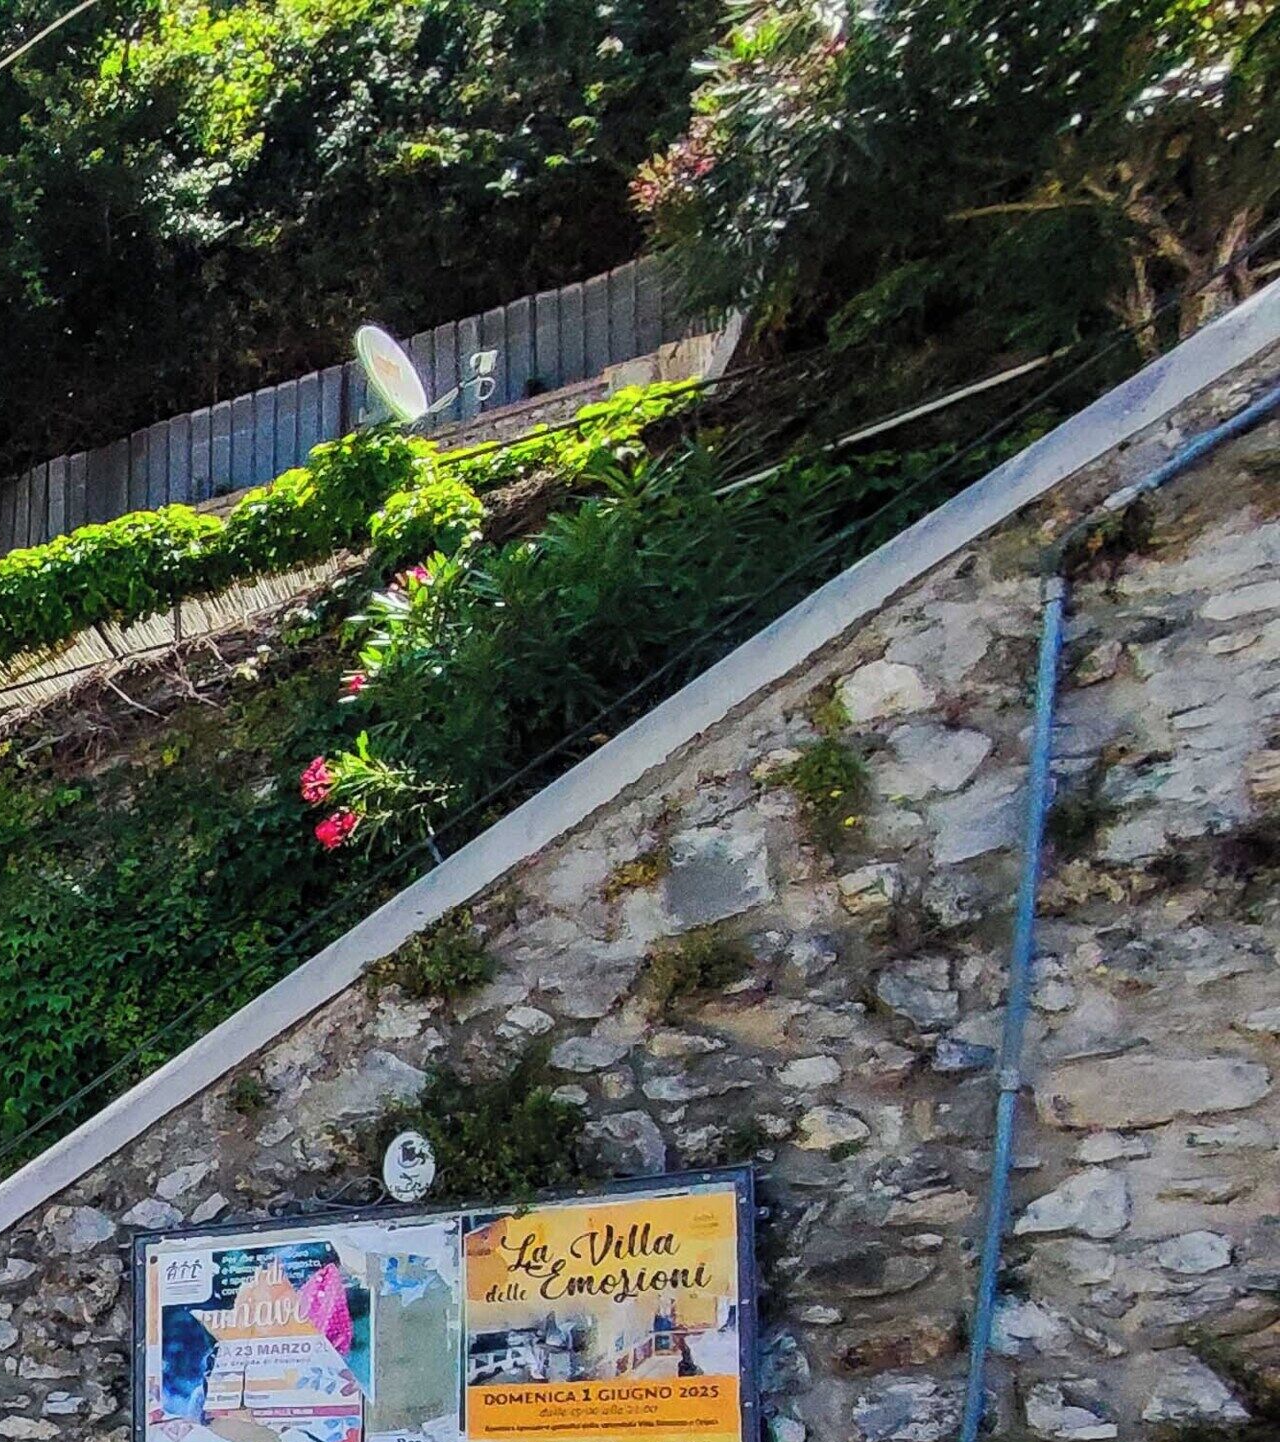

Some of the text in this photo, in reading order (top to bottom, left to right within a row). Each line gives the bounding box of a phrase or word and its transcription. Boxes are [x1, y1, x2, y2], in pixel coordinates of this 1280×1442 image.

[501, 1233, 553, 1272] La
[571, 1223, 681, 1266] Villa
[486, 1259, 712, 1303] delle Emozioni
[235, 1345, 253, 1356] 23
[257, 1342, 312, 1355] MARZO
[484, 1385, 720, 1406] DOMENICA 1 GIUGNO 2025
